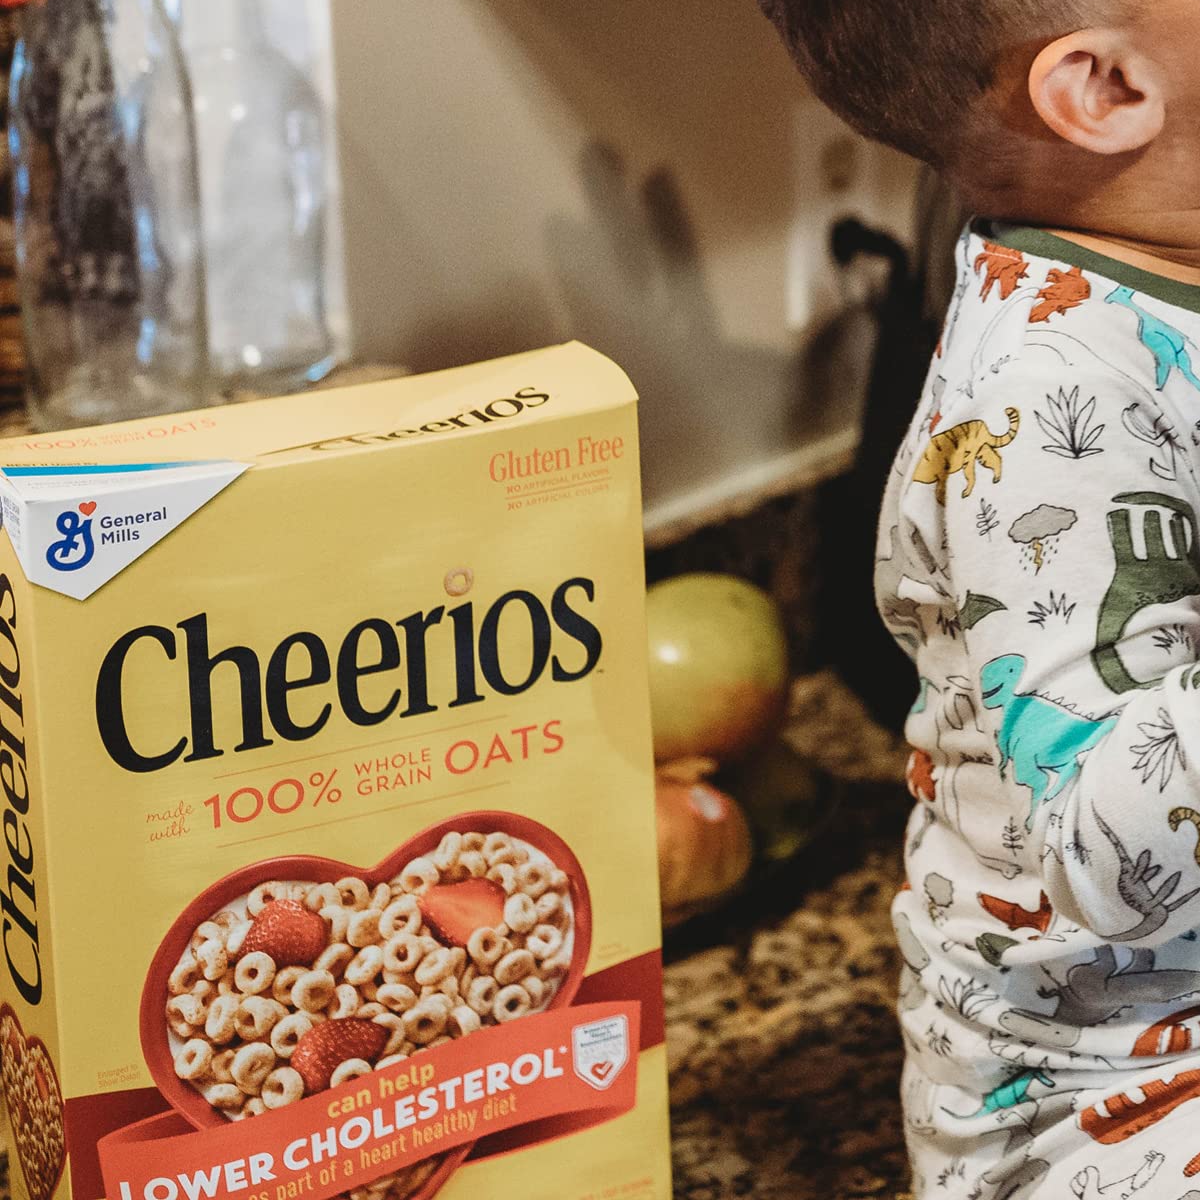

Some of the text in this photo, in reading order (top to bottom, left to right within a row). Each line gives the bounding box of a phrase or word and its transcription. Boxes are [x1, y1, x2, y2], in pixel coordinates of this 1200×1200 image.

[147, 417, 217, 439] OATS
[489, 436, 624, 483] Gluten Free
[100, 507, 167, 529] General
[101, 528, 140, 545] Mills
[95, 568, 604, 773] Cheerios
[354, 747, 432, 777] WHOLE
[444, 720, 565, 775] OATS
[356, 766, 432, 797] GRAIN
[144, 800, 194, 823] made
[203, 768, 342, 829] 100%
[150, 815, 190, 841] with
[327, 1063, 436, 1119] can help
[276, 1171, 314, 1200] part
[319, 1160, 338, 1186] of
[344, 1159, 354, 1177] a
[360, 1134, 407, 1169] heart
[412, 1107, 478, 1149] healthy
[483, 1093, 517, 1121] diet
